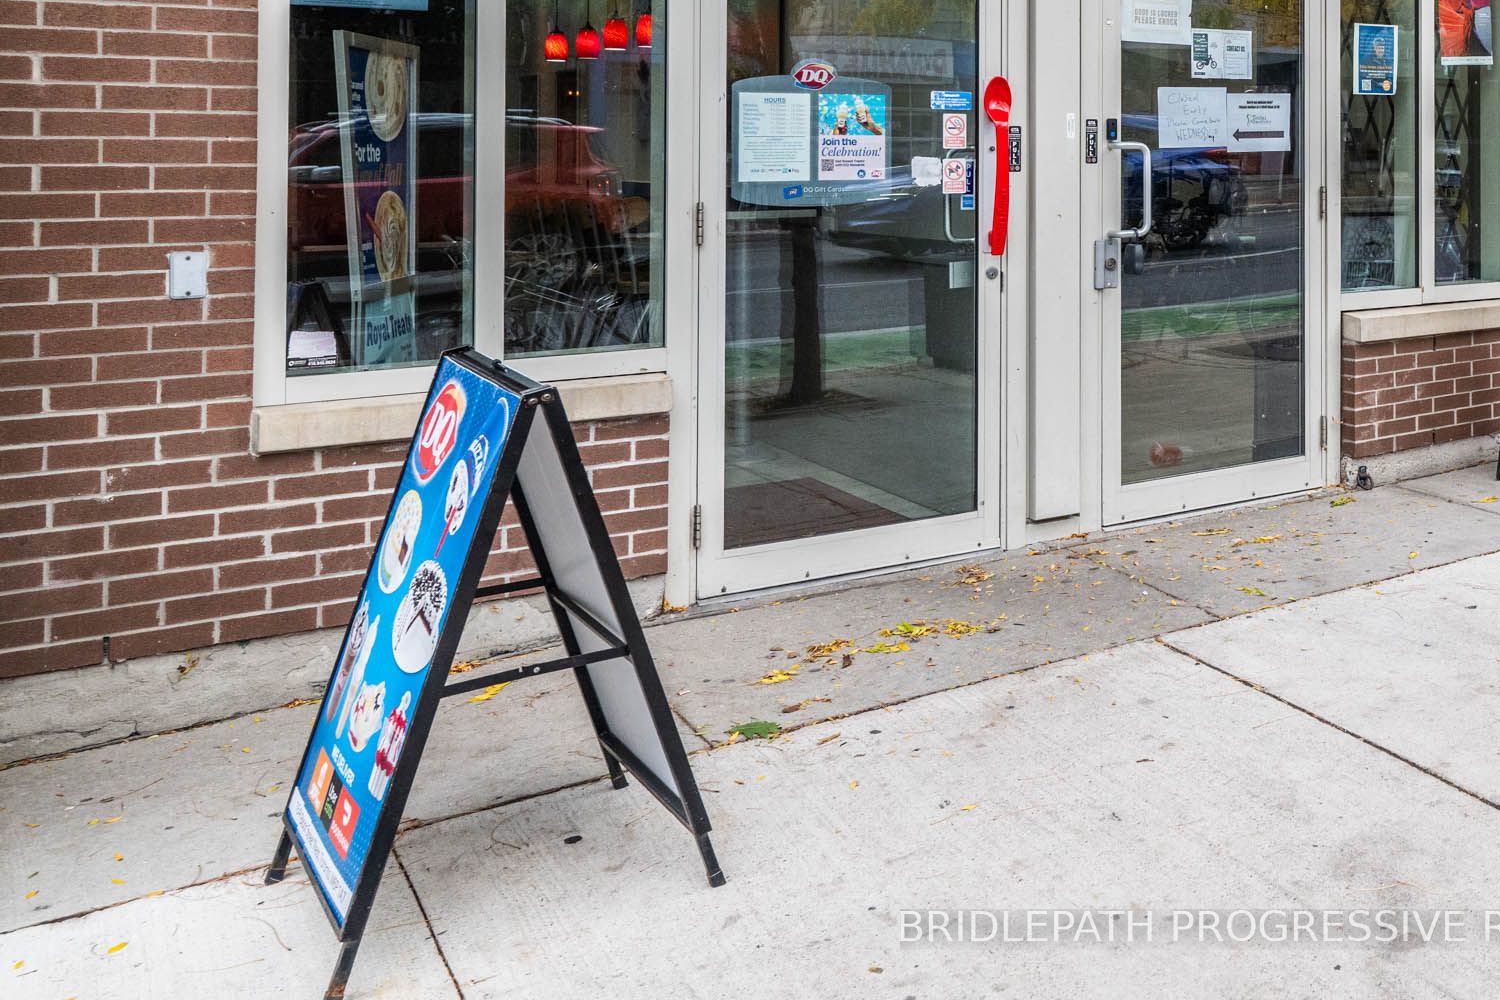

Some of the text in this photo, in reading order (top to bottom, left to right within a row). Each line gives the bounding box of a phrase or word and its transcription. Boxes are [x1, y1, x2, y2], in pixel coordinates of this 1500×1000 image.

[800, 69, 829, 85] DQ
[822, 138, 857, 146] Join the
[821, 146, 882, 157] Celebration!
[367, 317, 390, 350] Royal
[418, 401, 458, 467] DQ
